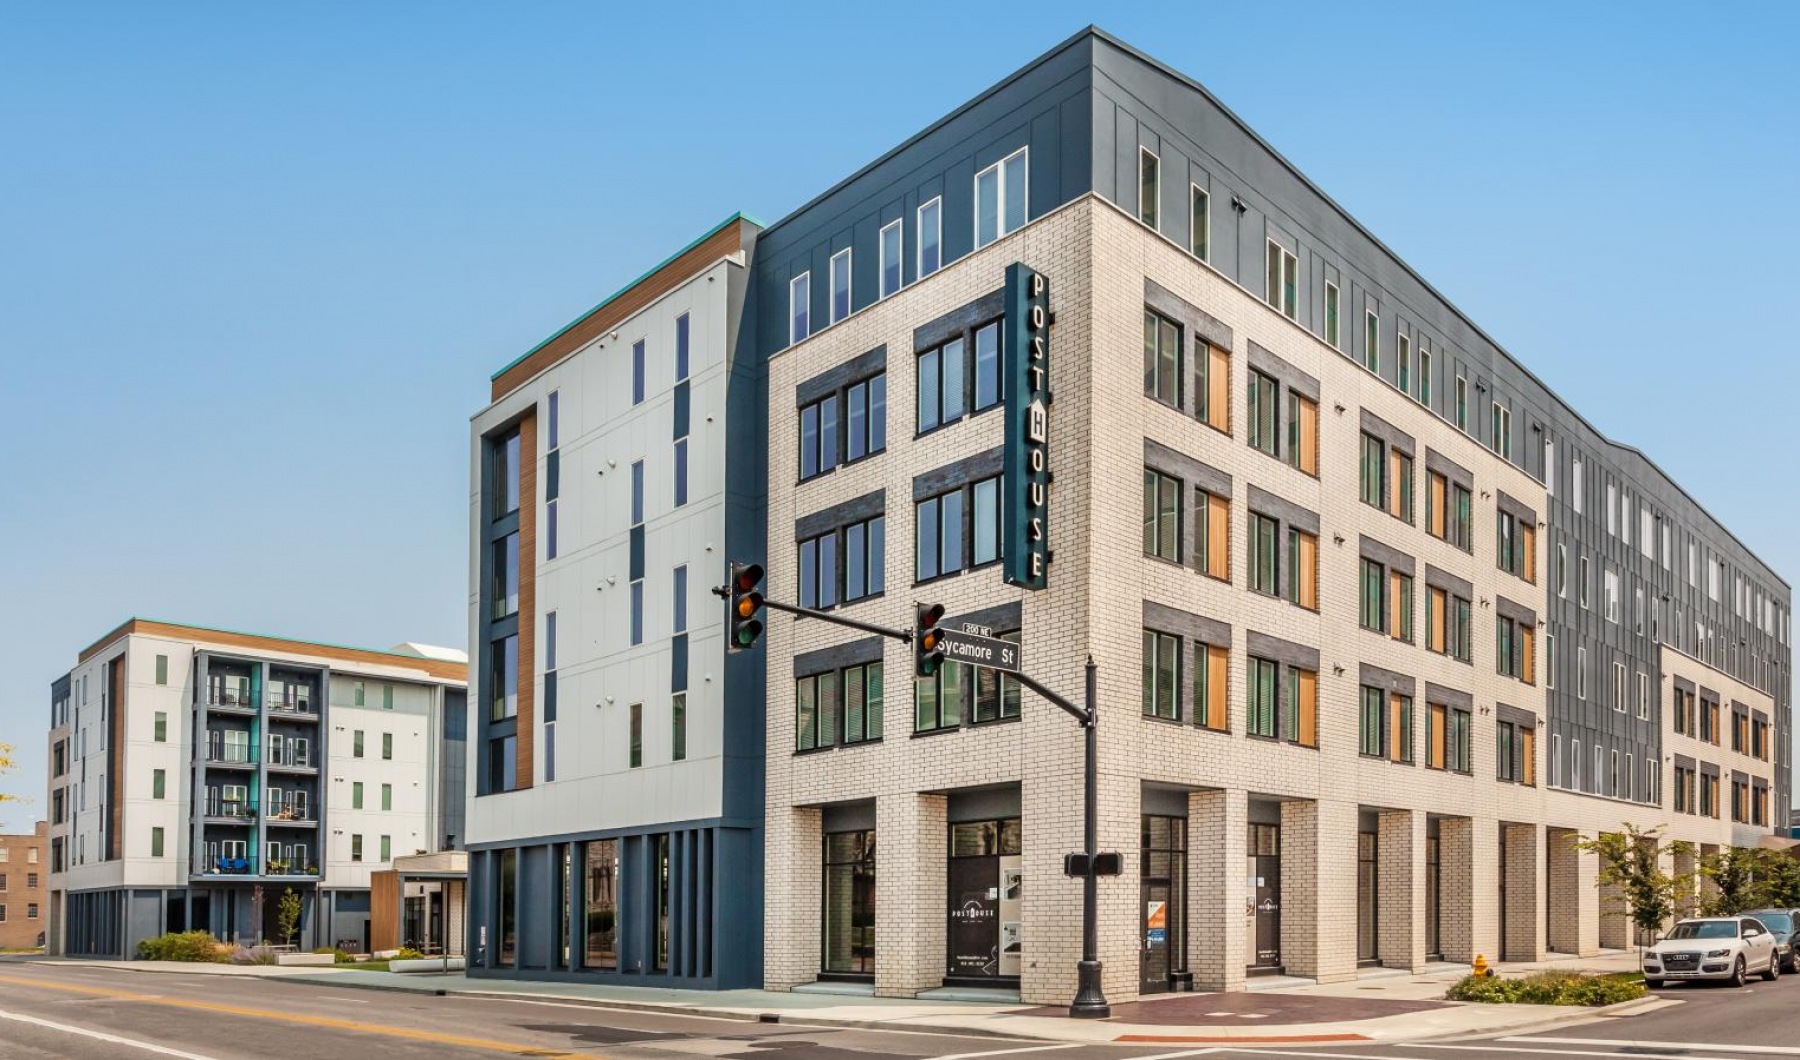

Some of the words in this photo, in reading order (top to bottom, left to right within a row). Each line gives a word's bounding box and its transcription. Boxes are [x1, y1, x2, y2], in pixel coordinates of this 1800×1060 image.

[1029, 272, 1047, 577] POSTHOUSE
[965, 624, 979, 634] 200
[981, 627, 990, 637] NE
[937, 640, 992, 660] Sycamore
[1001, 648, 1014, 664] St
